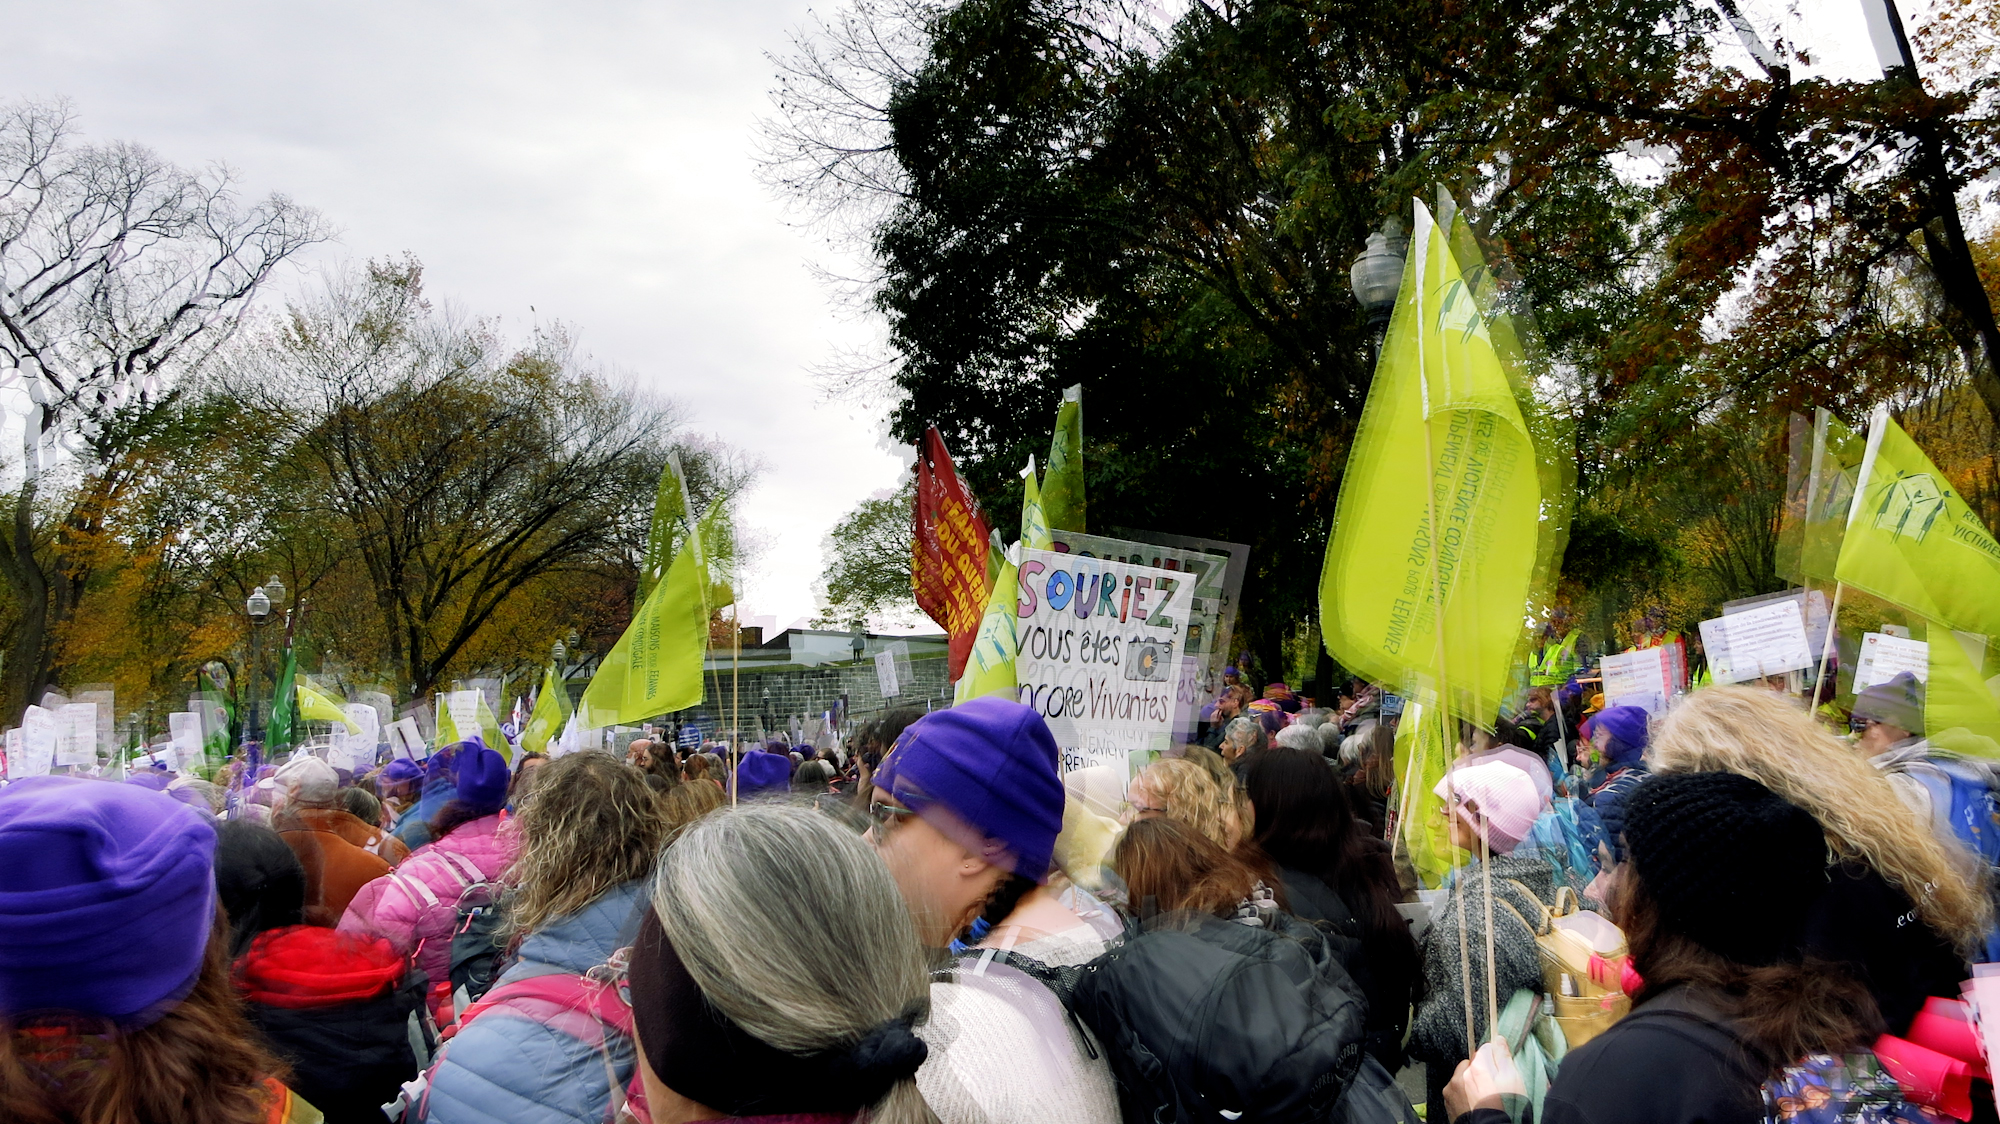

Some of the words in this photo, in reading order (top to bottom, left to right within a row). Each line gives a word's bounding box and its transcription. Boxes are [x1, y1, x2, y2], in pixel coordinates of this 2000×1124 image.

[937, 521, 960, 554] DU
[958, 553, 992, 613] QUEBE
[650, 616, 660, 650] MAISONS
[1090, 677, 1168, 722] Vivantes
[1336, 1043, 1358, 1069] OSPREY
